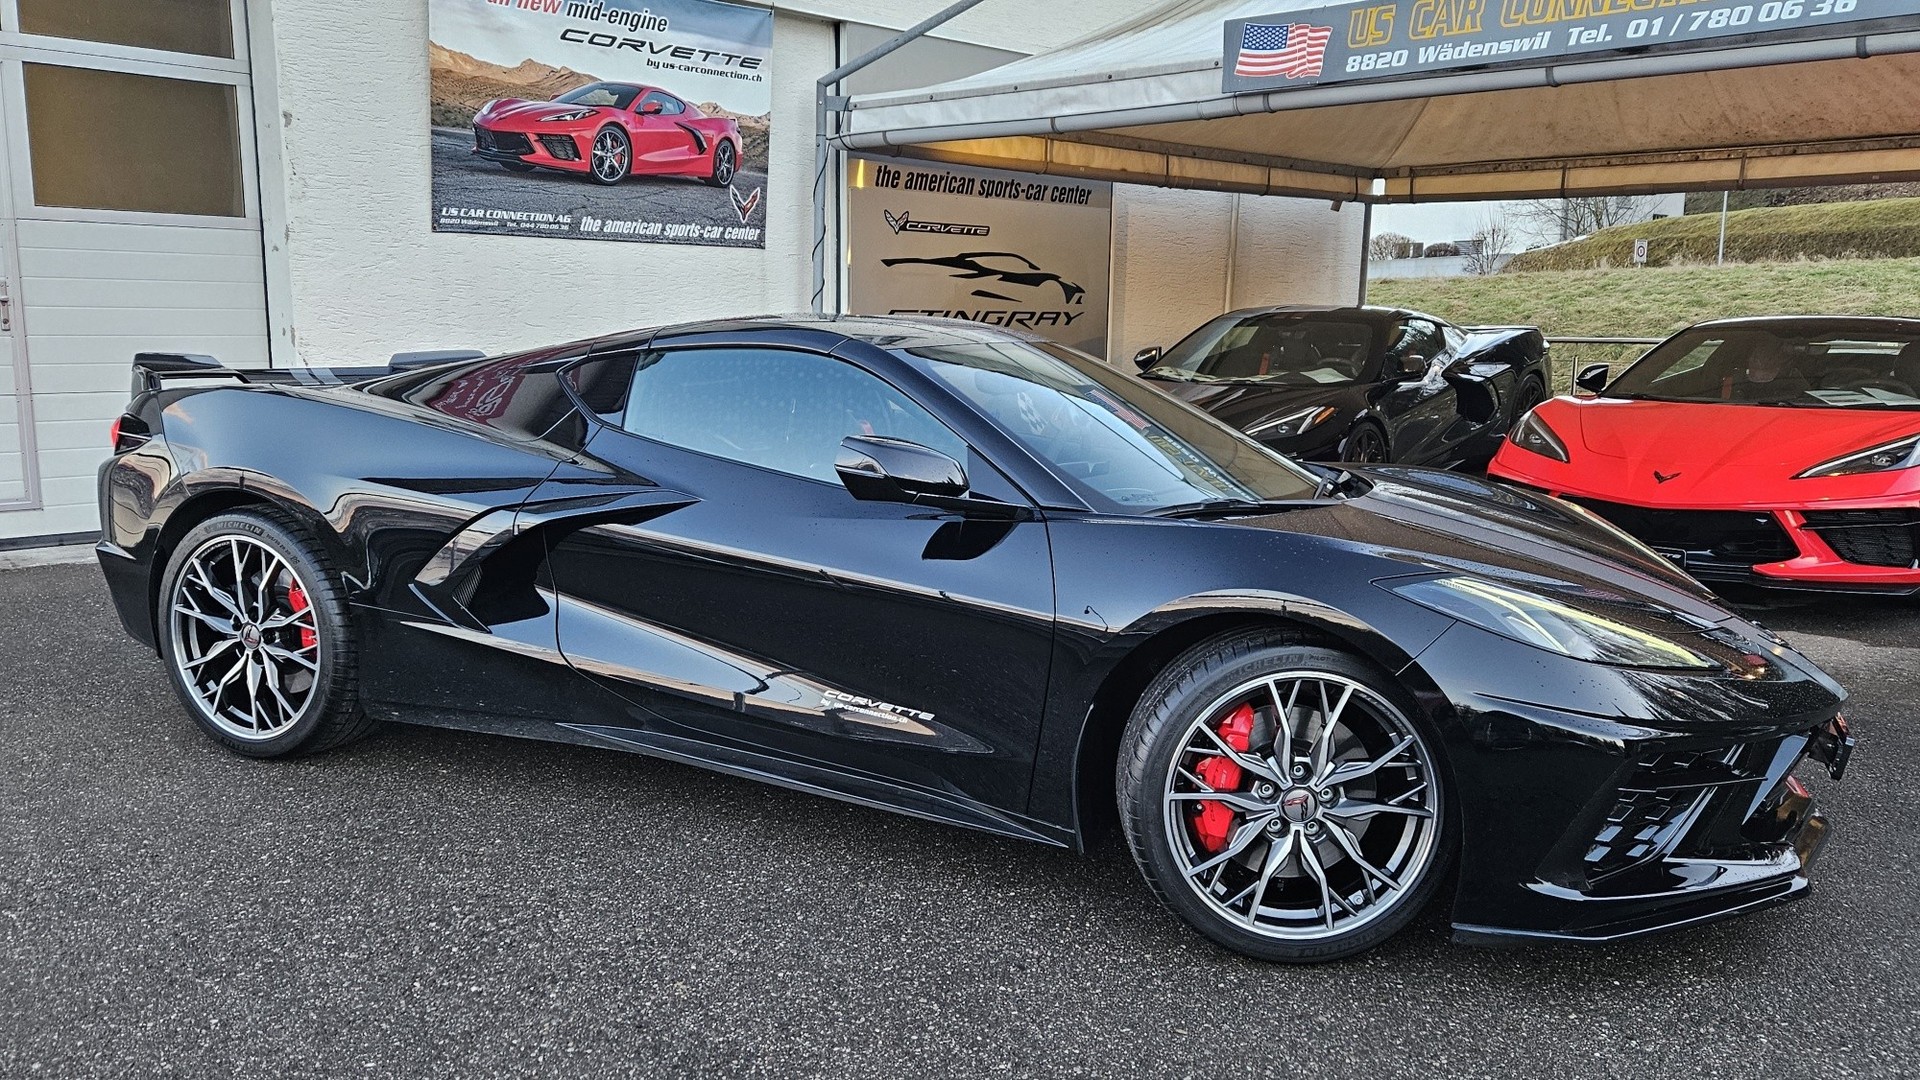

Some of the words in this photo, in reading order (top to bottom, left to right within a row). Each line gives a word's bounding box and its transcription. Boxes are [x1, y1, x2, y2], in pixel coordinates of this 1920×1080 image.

[566, 0, 668, 32] mid-engine
[1348, 4, 1396, 48] US
[1408, 0, 1486, 39] CAR
[559, 28, 763, 70] CORVETTE
[1345, 49, 1408, 73] 8820
[1418, 31, 1552, 64] Wädenswil
[1567, 24, 1613, 46] Tel.
[1626, 17, 1664, 39] 01
[1689, 6, 1753, 32] 780
[1757, 0, 1804, 23] 06
[646, 58, 660, 70] by
[662, 61, 763, 83] us-carconnection.ch
[875, 165, 900, 188] the
[903, 170, 976, 196] american
[977, 177, 1049, 202] sports-car
[1049, 184, 1093, 206] center
[441, 207, 460, 217] US
[460, 208, 485, 218] CAR
[486, 210, 556, 222] CONNECTION
[555, 214, 572, 223] AG
[580, 216, 601, 232] the
[603, 219, 663, 236] american
[663, 222, 724, 239] sports-car
[724, 226, 761, 241] center
[907, 222, 990, 235] CORVETTE
[824, 690, 935, 720] CORVETTE
